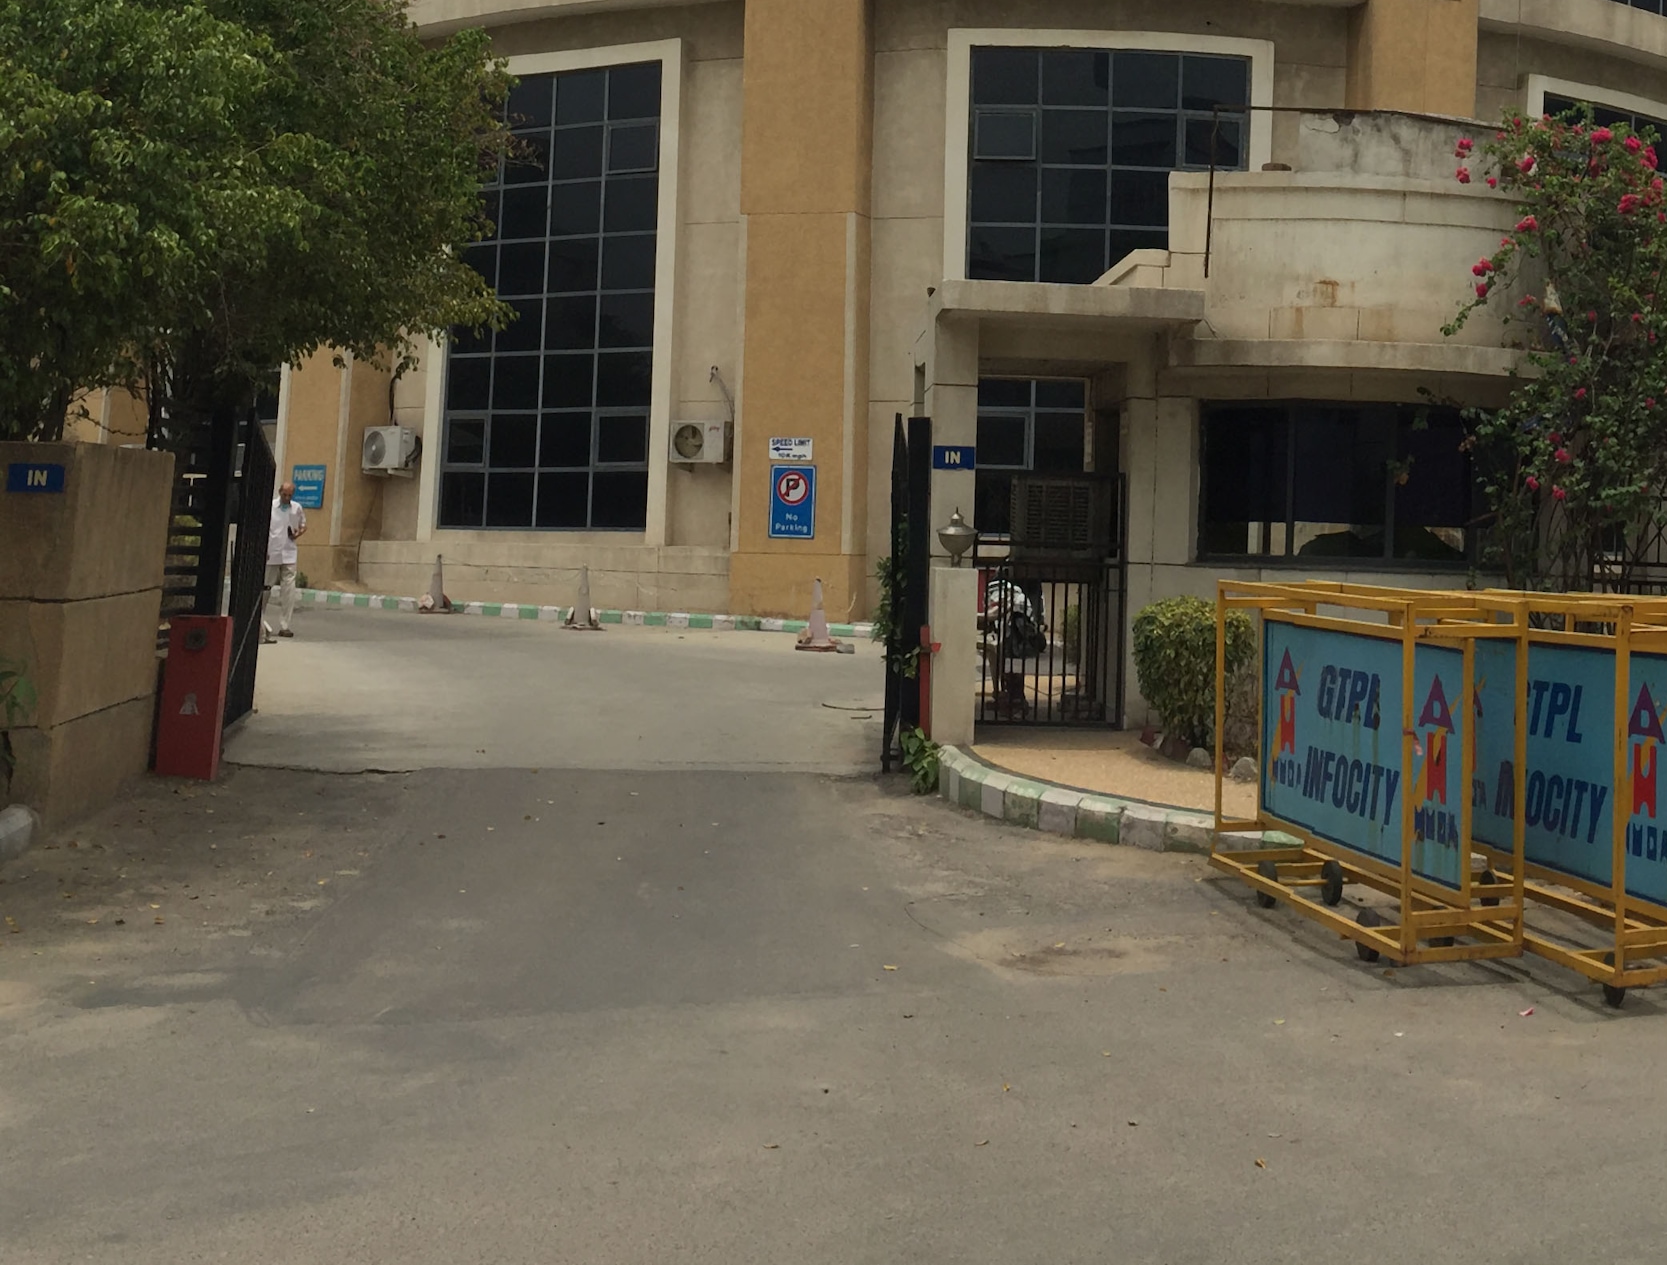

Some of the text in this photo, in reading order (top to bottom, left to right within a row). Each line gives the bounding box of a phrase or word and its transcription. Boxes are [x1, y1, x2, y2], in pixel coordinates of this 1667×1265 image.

[771, 438, 811, 446] SPEED LIMIT
[945, 450, 961, 464] IN
[26, 469, 48, 487] IN
[785, 512, 799, 521] No
[775, 522, 808, 534] Parking
[1317, 664, 1381, 732] GTPL
[1526, 679, 1583, 744] TPL
[1302, 745, 1400, 826] INFOCITY
[1494, 759, 1608, 844] INOCITY
